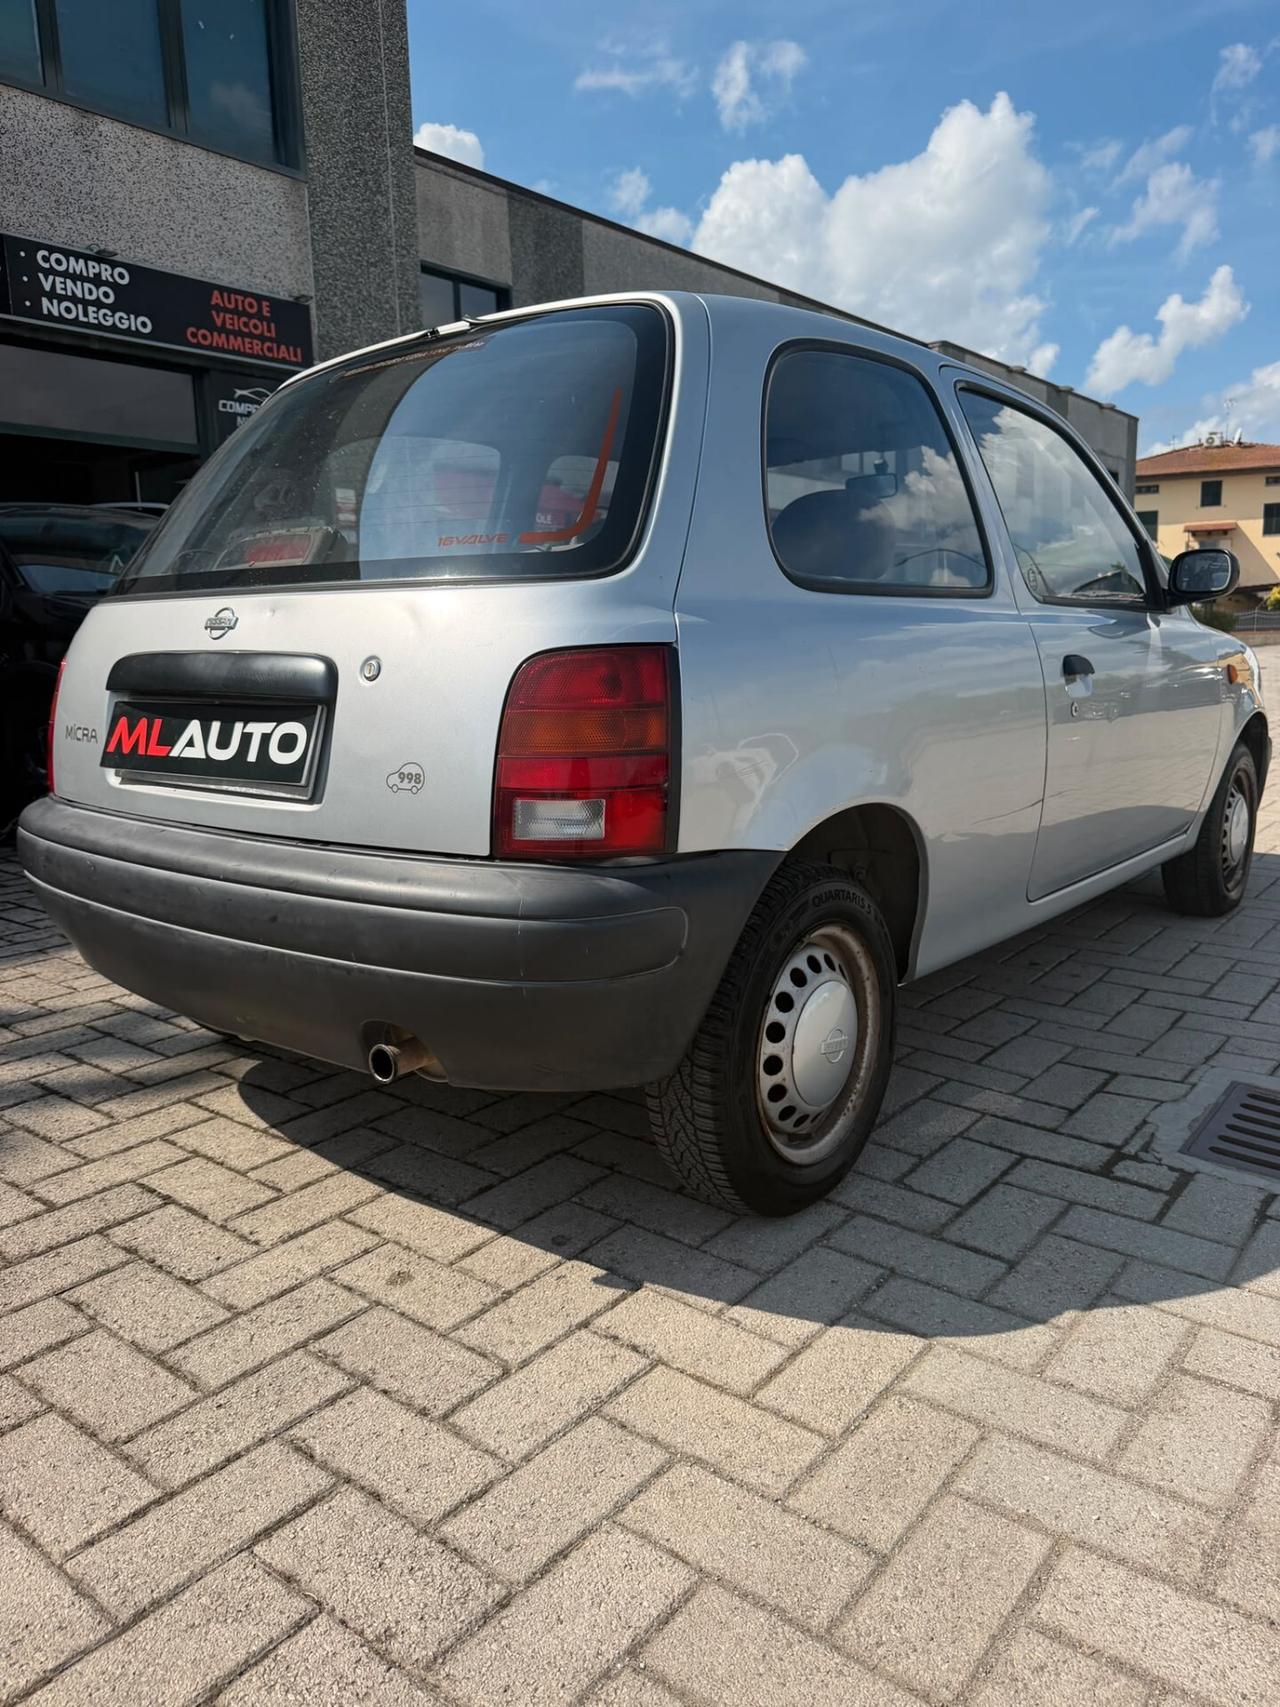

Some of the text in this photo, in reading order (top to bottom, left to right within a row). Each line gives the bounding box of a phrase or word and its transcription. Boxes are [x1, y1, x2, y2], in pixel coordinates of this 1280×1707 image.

[36, 249, 130, 285] COMPRO
[38, 273, 115, 304] VENDO
[41, 297, 153, 334] NOLEGGIO
[211, 290, 271, 317] AUTO E
[211, 310, 276, 337] VEICOLI
[186, 327, 302, 363] COMMERCIALI
[398, 771, 422, 785] 998
[812, 888, 865, 908] QUARTARIS
